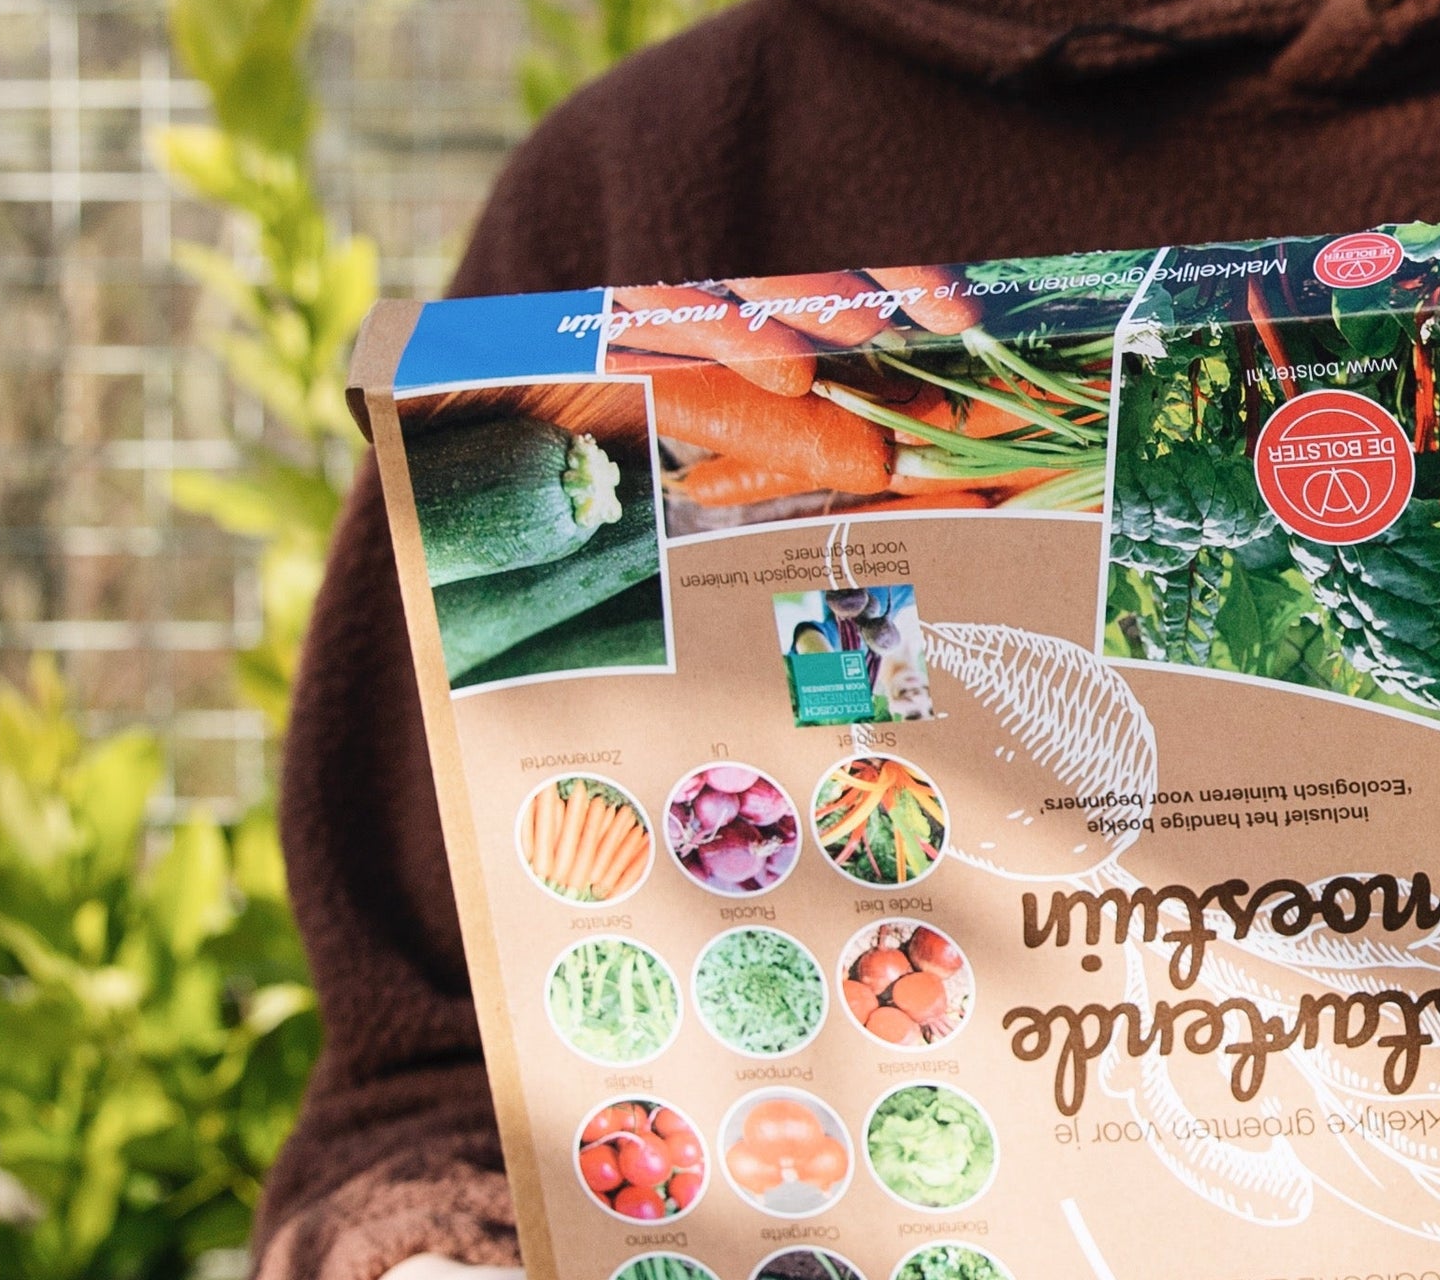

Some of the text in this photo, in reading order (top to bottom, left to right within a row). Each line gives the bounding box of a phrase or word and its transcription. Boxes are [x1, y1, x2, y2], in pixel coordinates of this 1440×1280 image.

[1324, 248, 1378, 261] BOLSTER
[557, 258, 1288, 339] Makkelijke groenten voor je startende moestuin
[1245, 357, 1398, 386] www.bolster.nl
[1267, 436, 1396, 463] DE BOLSTER
[871, 541, 907, 556] voor
[853, 559, 910, 576] Boekje
[680, 570, 749, 590] tuinieren
[836, 730, 897, 749] Snijbet
[711, 742, 728, 758] Ui
[520, 750, 622, 771] Zomerwortel
[1039, 779, 1412, 815] ‘Ecologisch tuinieren voor beginners’
[1086, 805, 1370, 836] inclusief het handige boekje
[720, 905, 776, 922] Rucola
[854, 898, 933, 915] Rode biet
[570, 914, 632, 930] Senator
[735, 1064, 814, 1082] Pompoen
[1054, 1117, 1086, 1150] je
[1090, 1121, 1160, 1144] voor
[1172, 1106, 1315, 1144] groenten
[626, 1232, 688, 1248] Domino
[760, 1223, 841, 1242] Courgette
